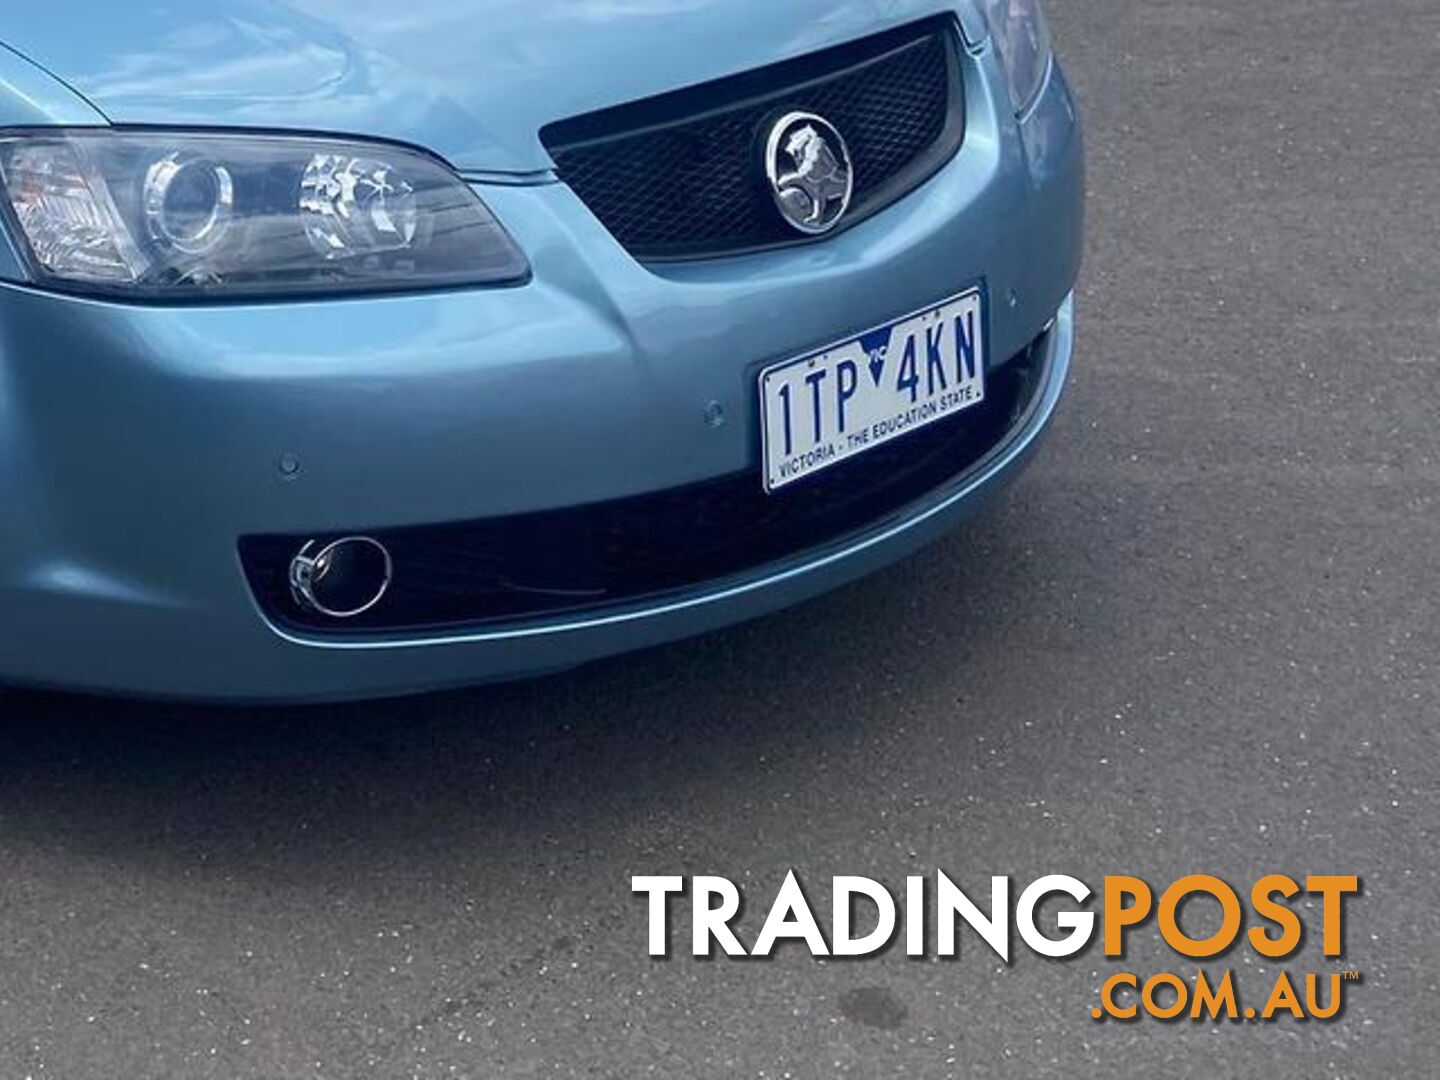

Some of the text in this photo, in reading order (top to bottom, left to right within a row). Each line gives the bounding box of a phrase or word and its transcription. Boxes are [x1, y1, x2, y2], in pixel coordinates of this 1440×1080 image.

[778, 310, 976, 457] 1TP 4KN
[778, 443, 836, 478] VICTORIA
[846, 427, 869, 449] THE
[872, 401, 938, 440] EDUCATION
[939, 385, 973, 411] STATE
